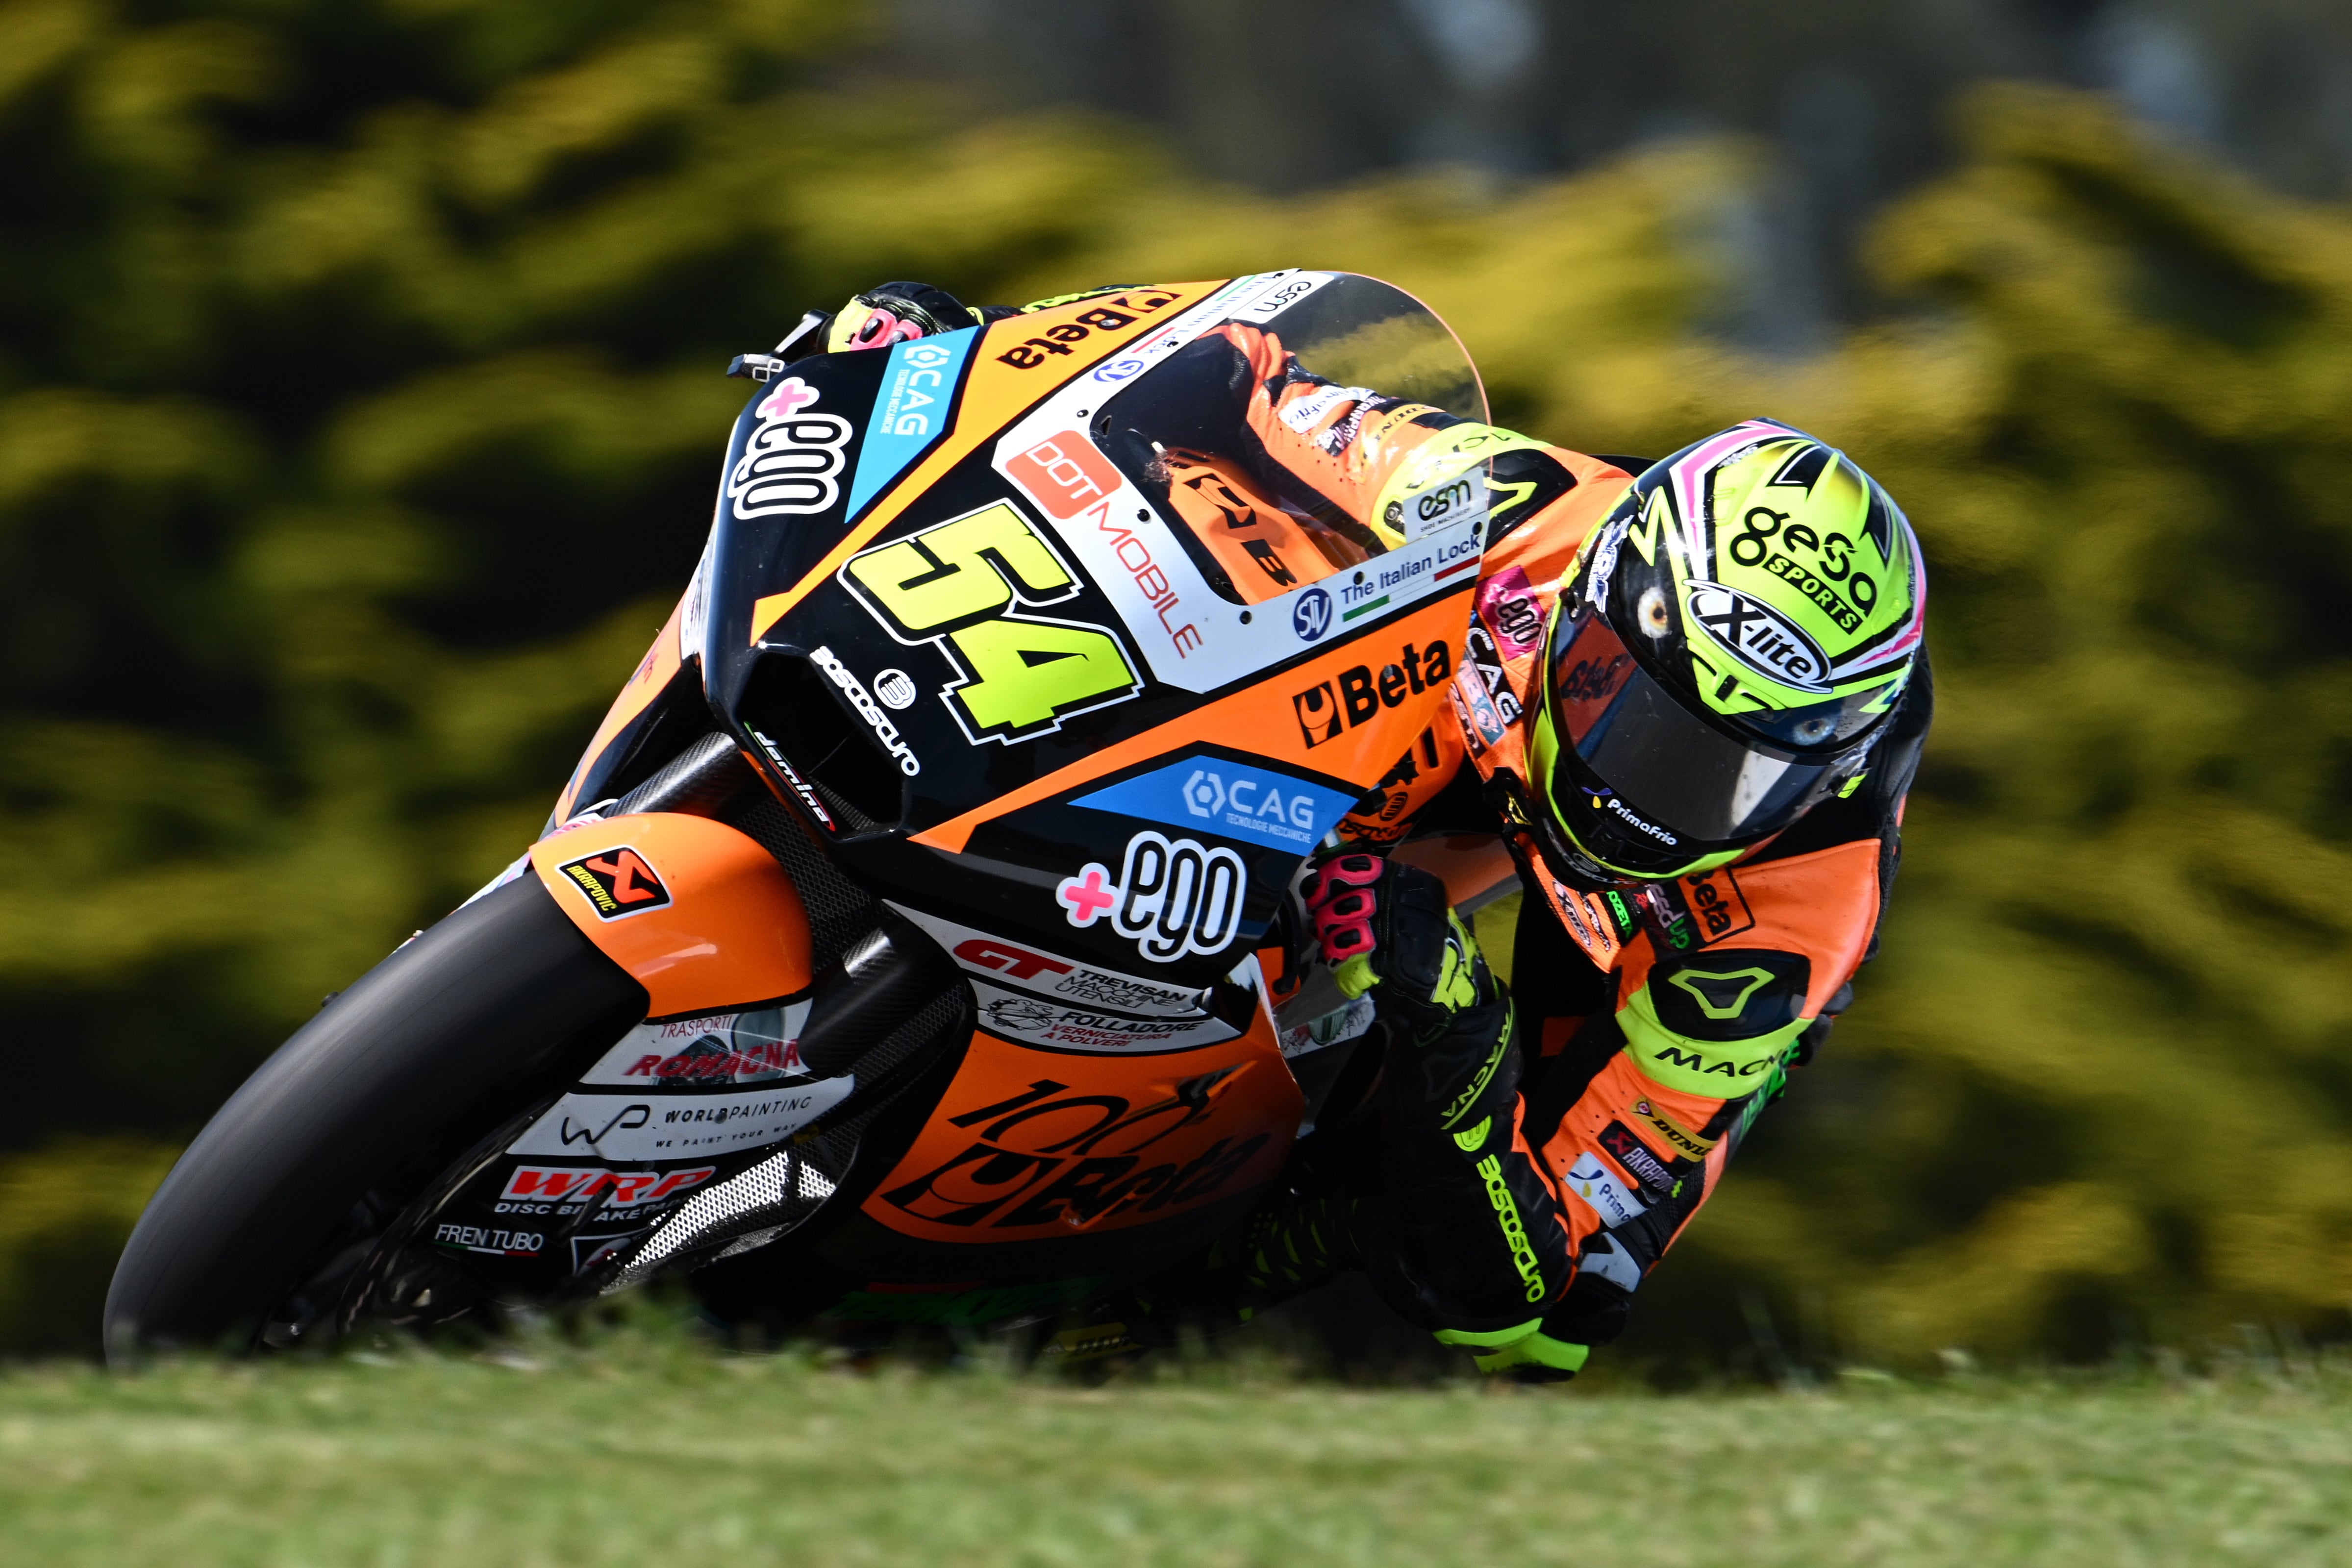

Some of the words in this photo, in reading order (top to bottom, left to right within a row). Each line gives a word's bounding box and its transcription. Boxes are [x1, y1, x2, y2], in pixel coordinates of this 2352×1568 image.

[996, 307, 1141, 370] Beta
[879, 398, 901, 435] MECCANICHE
[894, 369, 942, 436] CAG
[1026, 440, 1103, 499] DOT
[1418, 479, 1472, 522] esm
[1420, 520, 1437, 533] SHOE
[1086, 501, 1203, 659] MOBILE
[1340, 582, 1375, 605] The
[1379, 557, 1432, 590] Italian
[1438, 534, 1481, 563] Lock
[1767, 556, 1859, 632] SPORTS
[842, 500, 1139, 735] 54
[1698, 593, 1813, 680] X-lite
[1338, 639, 1452, 729] Beta
[1466, 626, 1524, 726] CAG
[753, 731, 831, 824] domino
[1228, 780, 1314, 830] CAG
[1606, 798, 1678, 846] PrimaFrio
[1226, 812, 1269, 833] TECNOLOGIE
[1268, 822, 1312, 845] MECCANICHE
[953, 939, 1075, 980] GT
[1063, 976, 1177, 1007] MACCHINE
[1078, 970, 1187, 1002] TREVISAN
[660, 1014, 732, 1039] TRASPORTI
[1051, 1024, 1172, 1041] VERNICIATURA
[1057, 1034, 1132, 1047] POLVERI
[1059, 1011, 1206, 1033] FOLLADORE
[622, 1038, 800, 1077] ROMAGNA
[682, 1136, 722, 1146] PAINT
[732, 1130, 763, 1141] YOUR
[501, 1166, 716, 1207] WRP
[494, 1202, 551, 1215] DISC
[434, 1224, 489, 1246] FREN
[492, 1229, 544, 1252] TUBO
